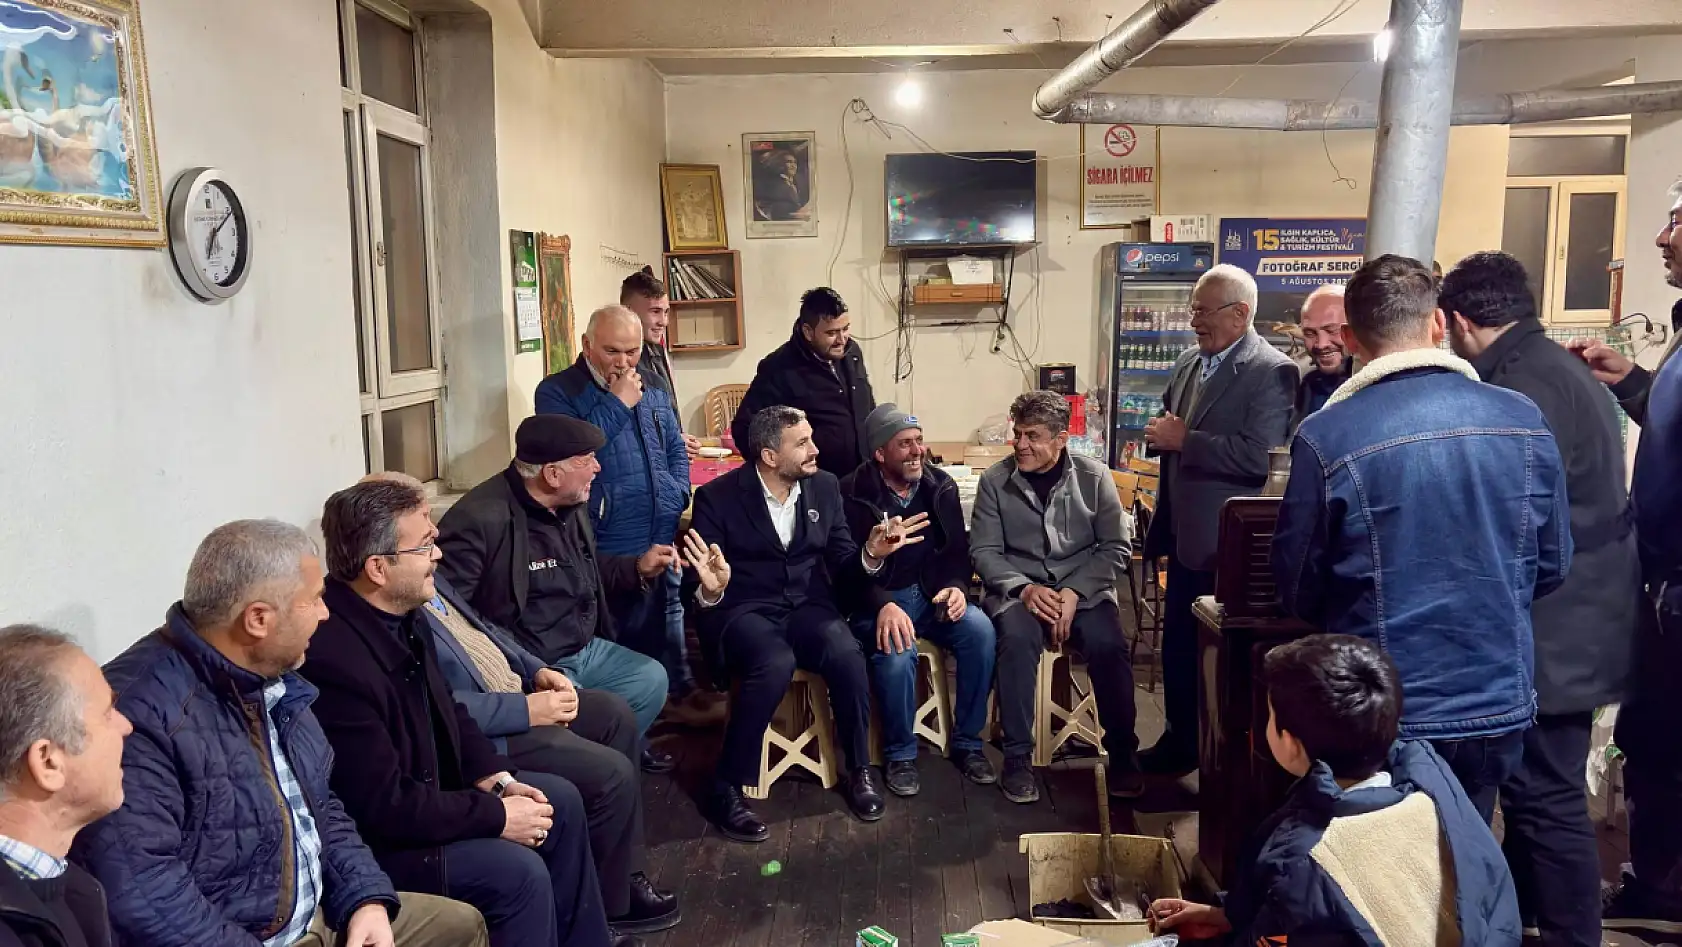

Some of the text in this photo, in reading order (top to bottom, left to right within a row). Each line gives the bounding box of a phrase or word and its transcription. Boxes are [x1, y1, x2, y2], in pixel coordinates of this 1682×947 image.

[1087, 165, 1153, 186] SİGARA İÇİLMEZ
[1253, 229, 1280, 250] 15
[1145, 252, 1180, 265] pepsi
[1262, 260, 1324, 273] FOTOĞRAF
